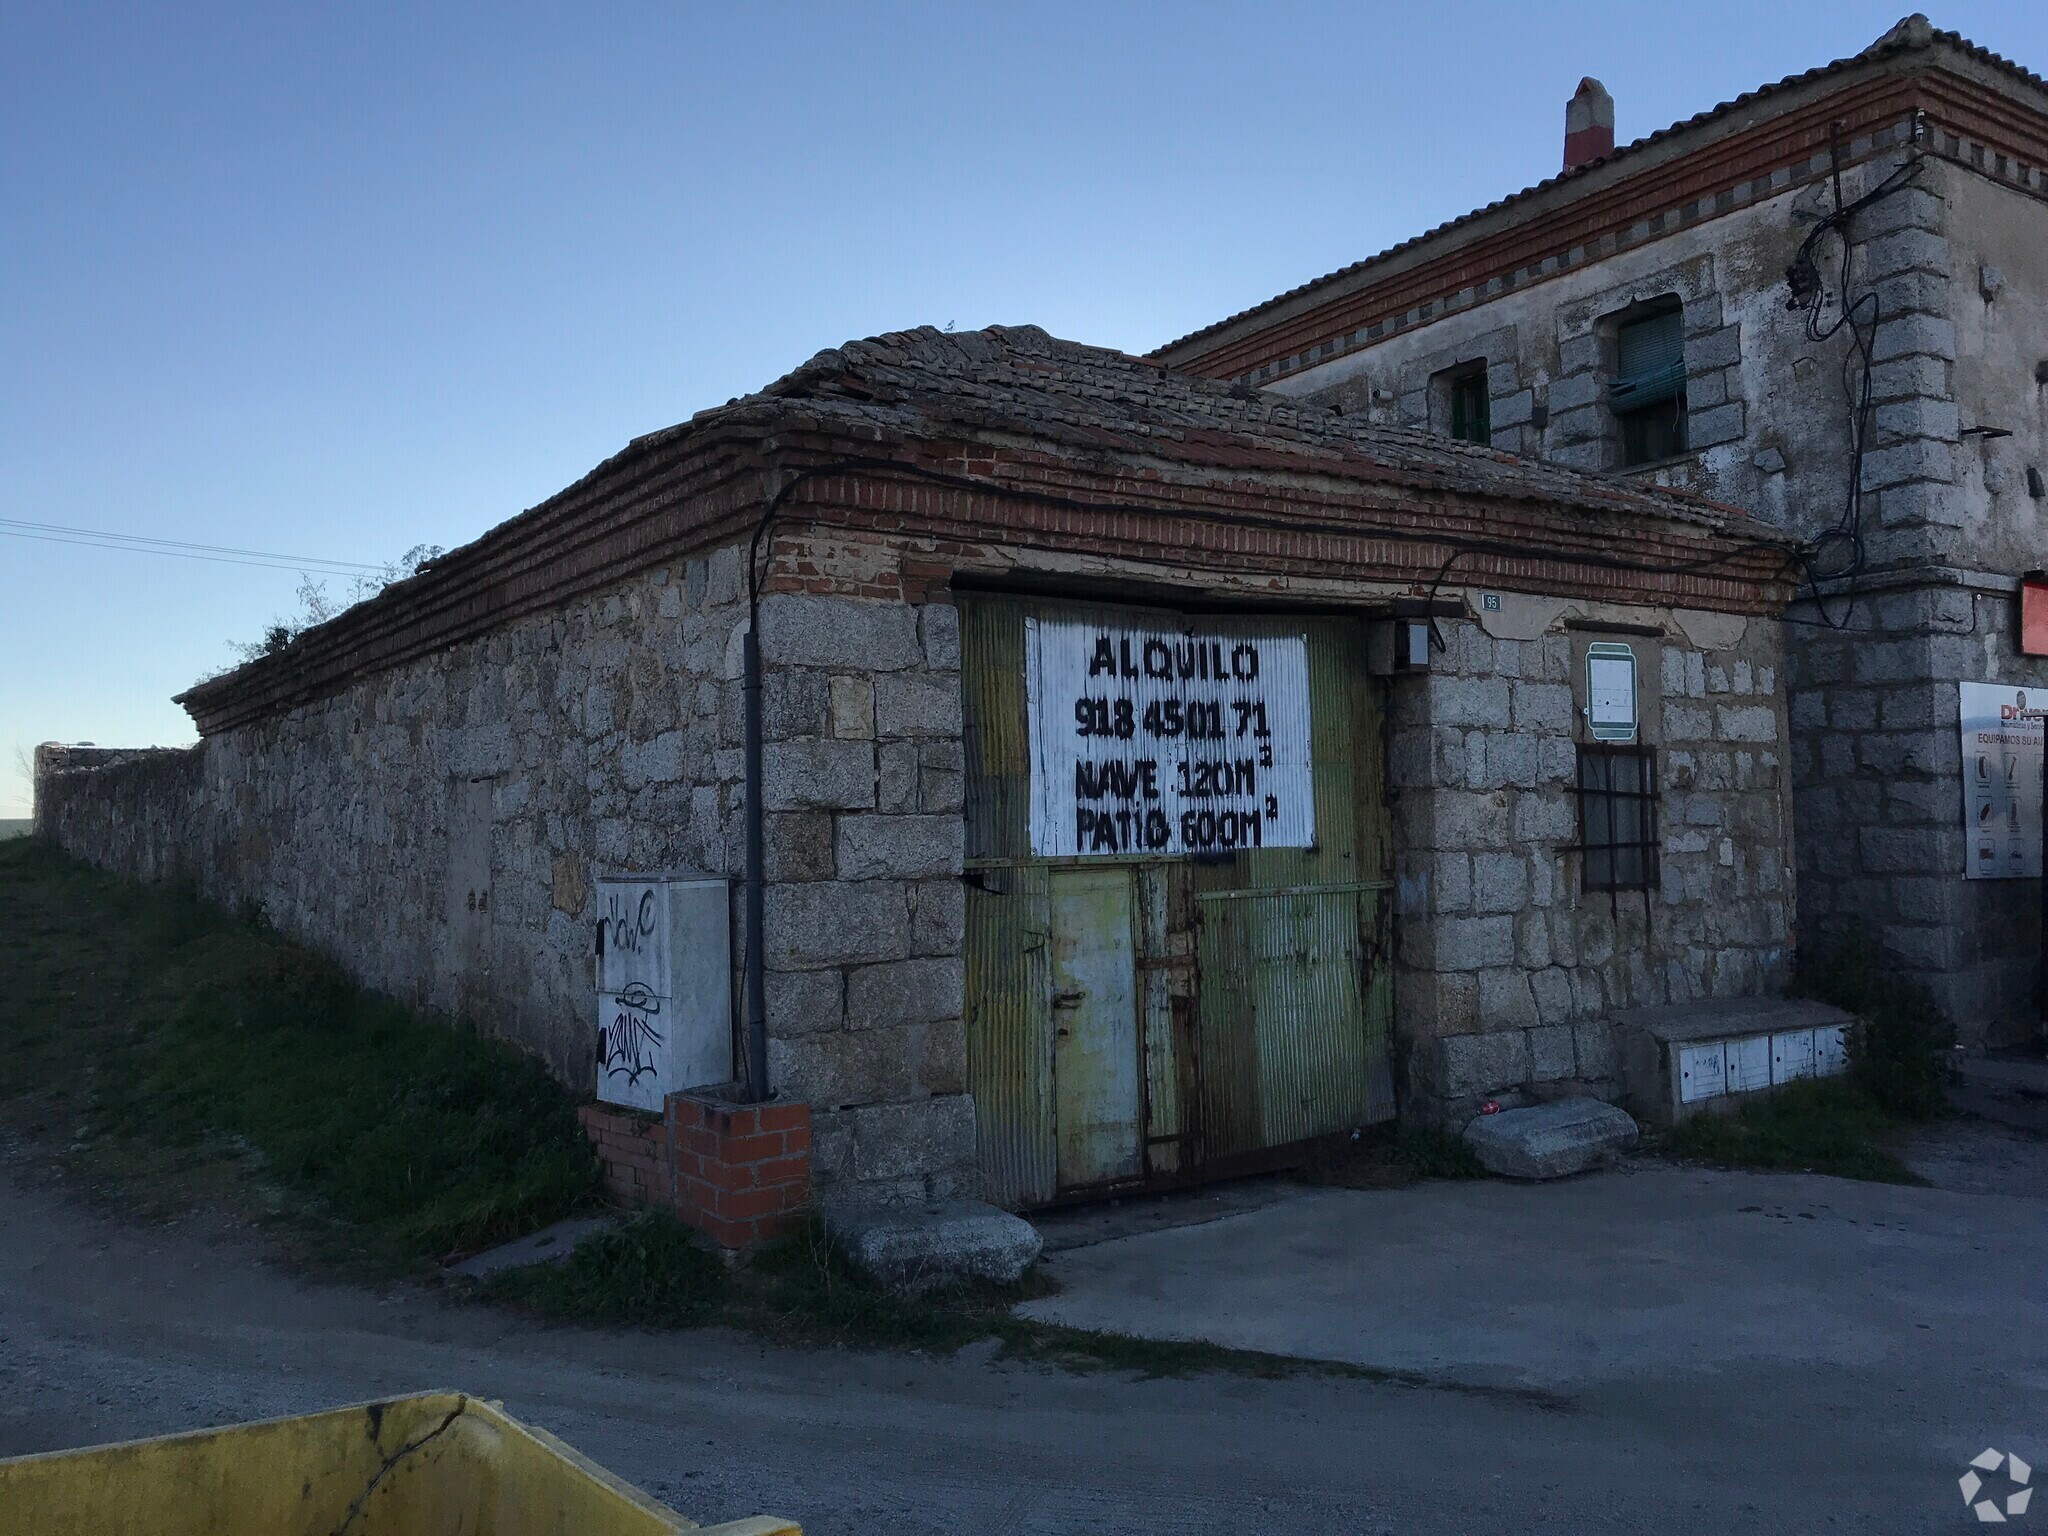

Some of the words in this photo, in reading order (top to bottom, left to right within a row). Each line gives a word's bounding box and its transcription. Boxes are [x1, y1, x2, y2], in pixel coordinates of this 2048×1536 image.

[1487, 596, 1497, 608] 95
[1089, 636, 1259, 682] ALQUILO
[1978, 733, 2020, 745] EQUIPAMOS
[2022, 736, 2031, 746] SU
[1076, 758, 1159, 800] NAVE
